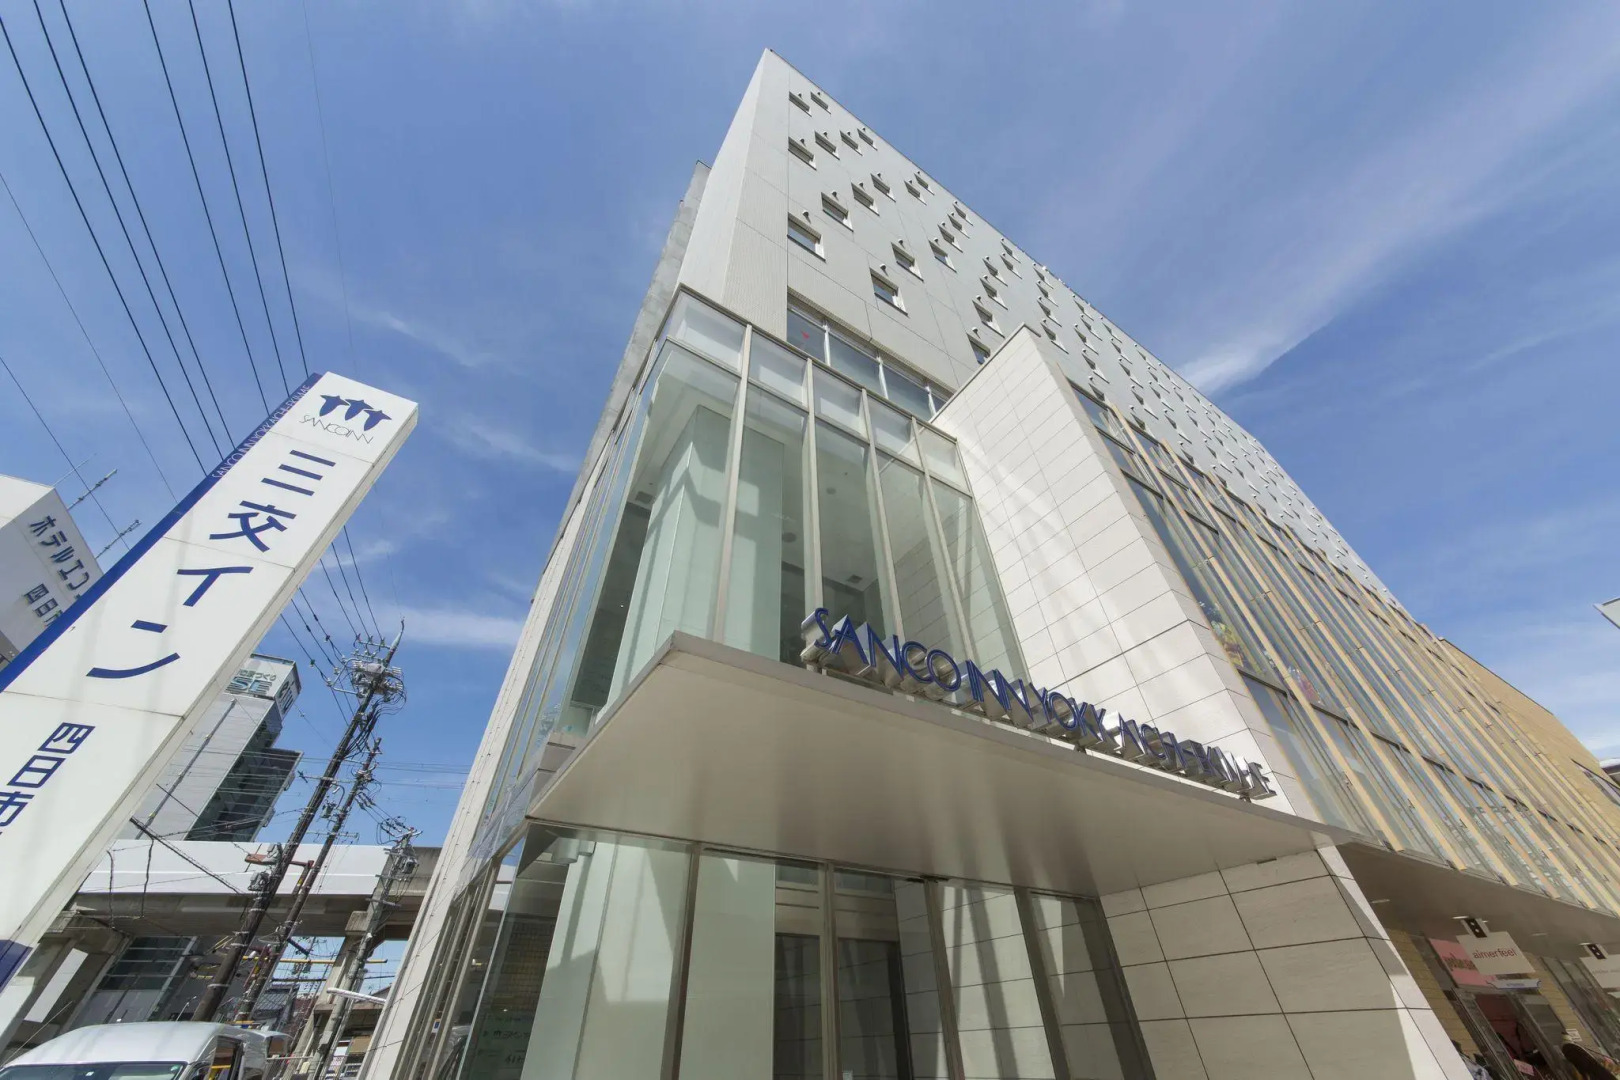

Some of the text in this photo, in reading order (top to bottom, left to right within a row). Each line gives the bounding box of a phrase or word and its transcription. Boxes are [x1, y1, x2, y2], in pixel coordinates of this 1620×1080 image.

[29, 515, 90, 600] ホテルエコ
[0, 449, 336, 836] 三交イン 四日市
[1471, 947, 1517, 960] aimerfeel
